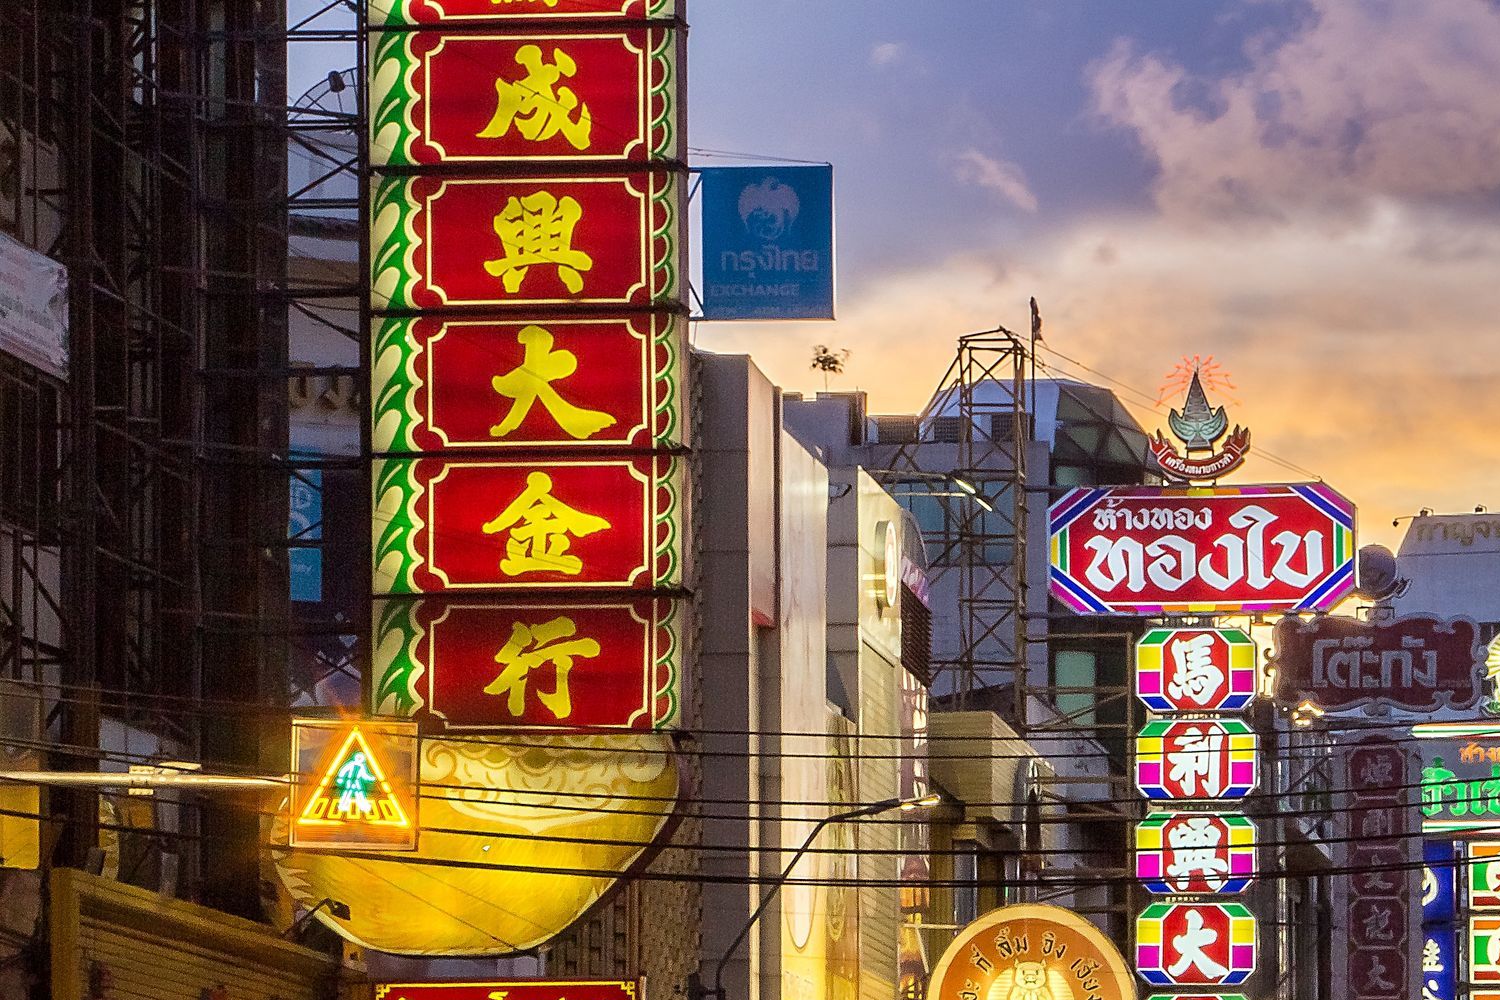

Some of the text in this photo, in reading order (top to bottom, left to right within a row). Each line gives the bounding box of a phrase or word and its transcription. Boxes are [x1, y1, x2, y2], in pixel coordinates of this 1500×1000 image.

[720, 243, 819, 279] กรุงไทย
[476, 0, 620, 719] 成興大金行
[1092, 498, 1213, 530] ห้างทอง
[1083, 504, 1325, 593] ทองใบ
[1311, 636, 1438, 689] โต๊ะกัง
